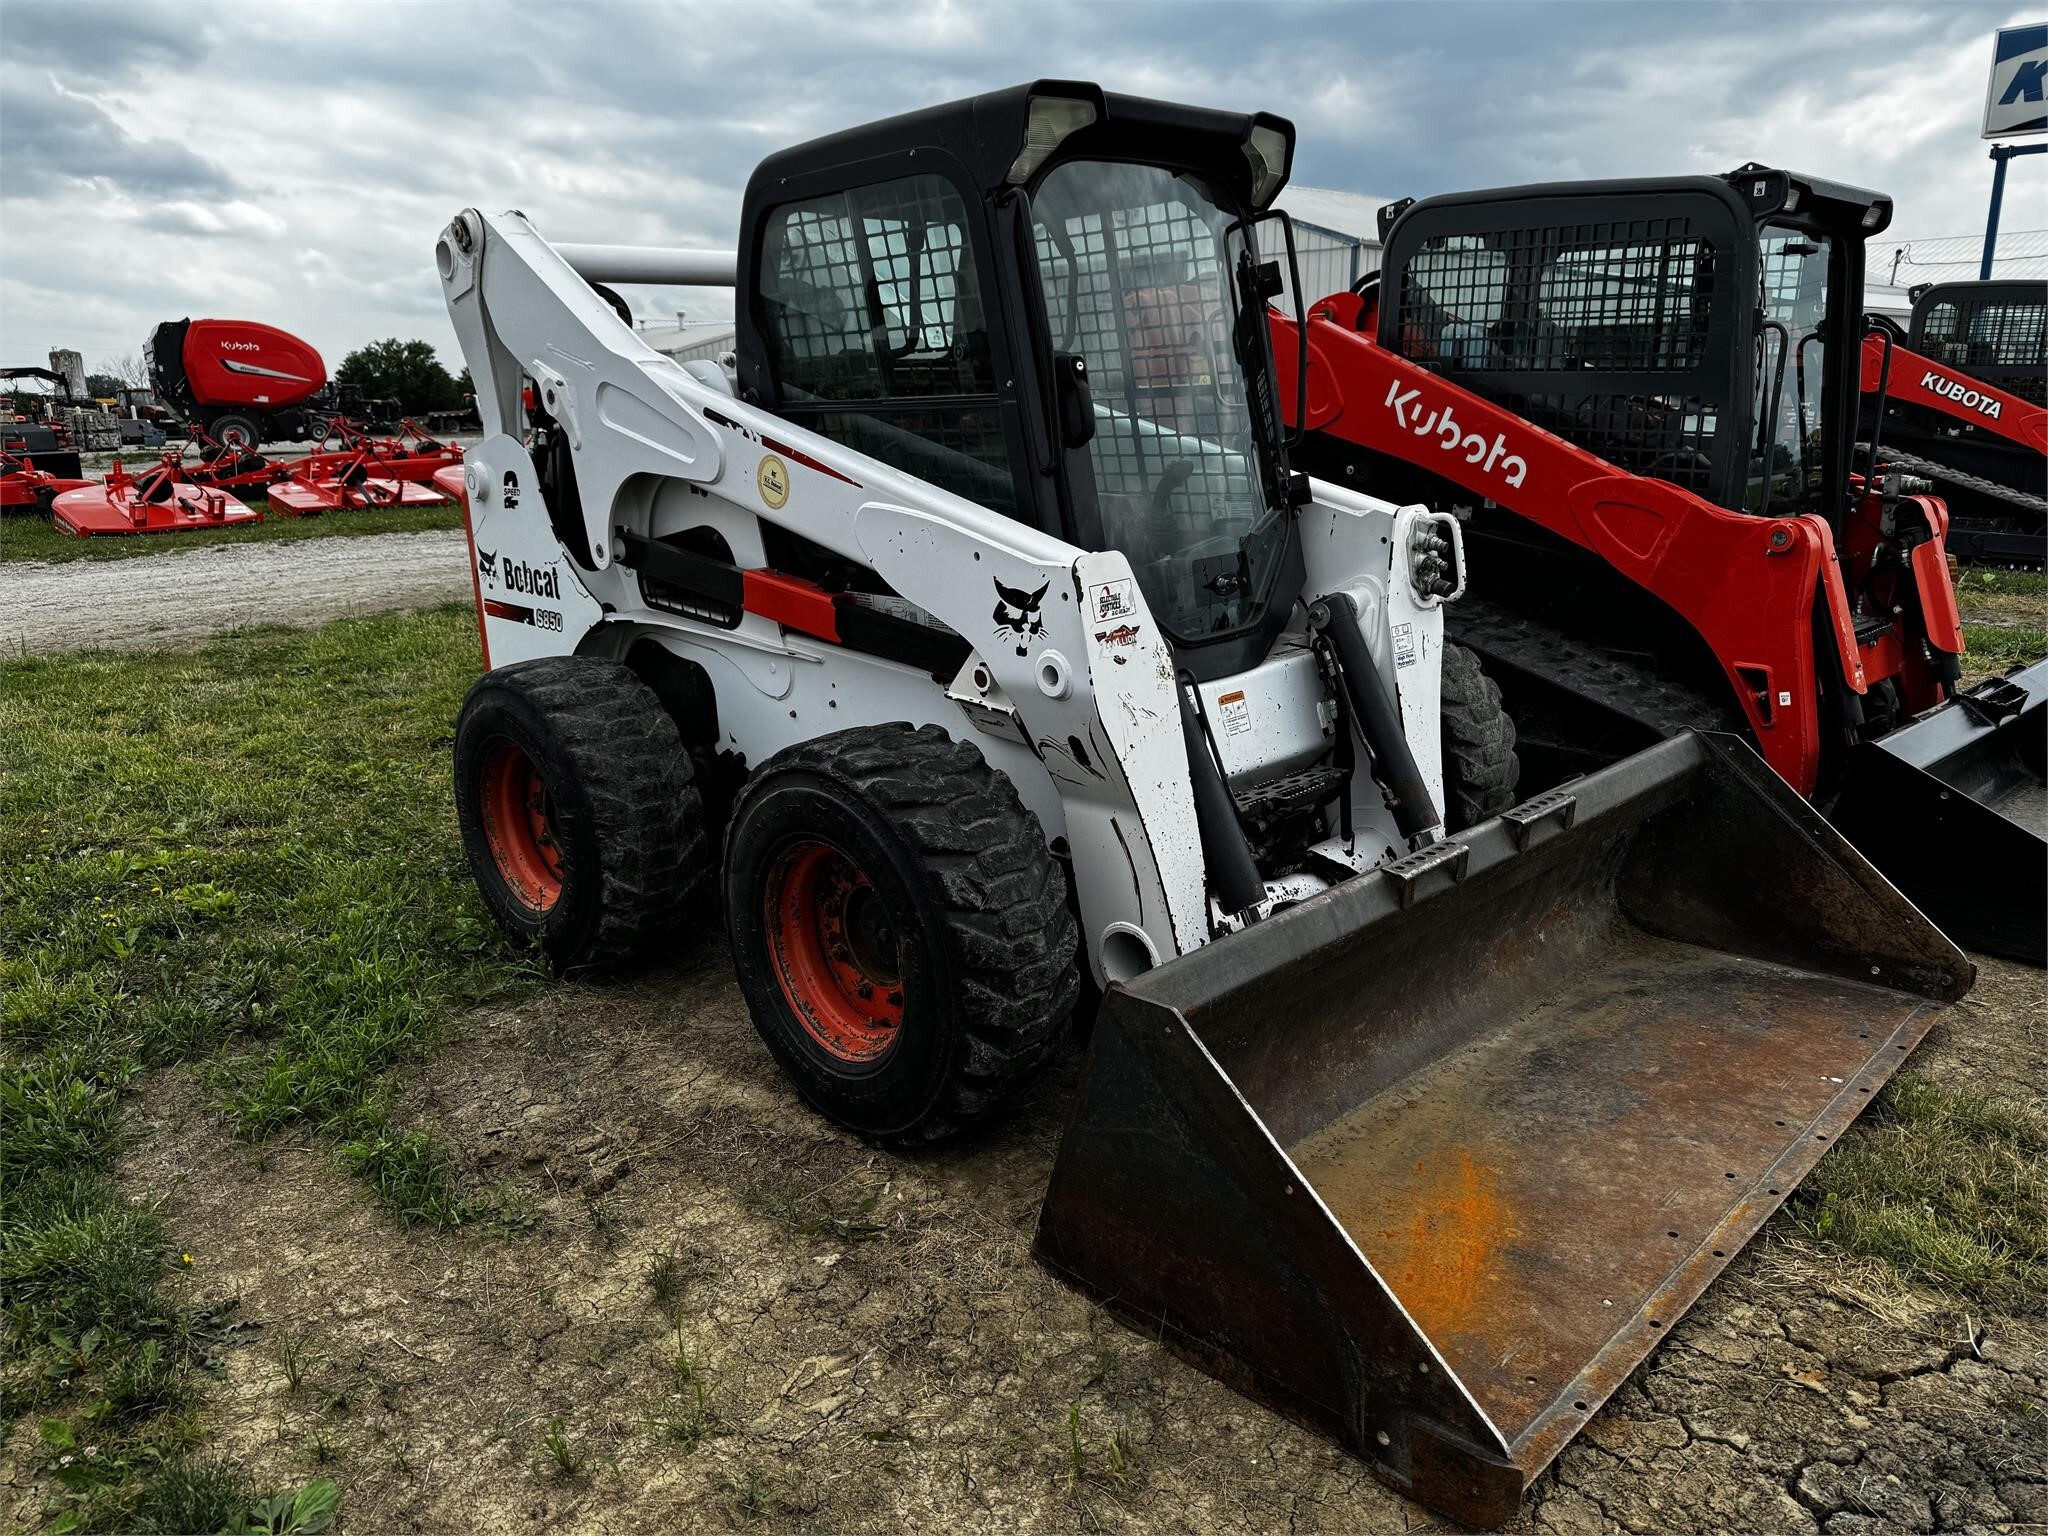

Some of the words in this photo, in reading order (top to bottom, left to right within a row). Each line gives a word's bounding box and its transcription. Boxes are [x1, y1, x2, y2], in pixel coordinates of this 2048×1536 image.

[221, 340, 260, 351] Kubota
[1920, 371, 2002, 420] KUBOTA
[1384, 379, 1527, 489] Kubota
[503, 487, 520, 496] SPEED
[502, 557, 561, 600] Bobcat
[535, 608, 563, 632] S850
